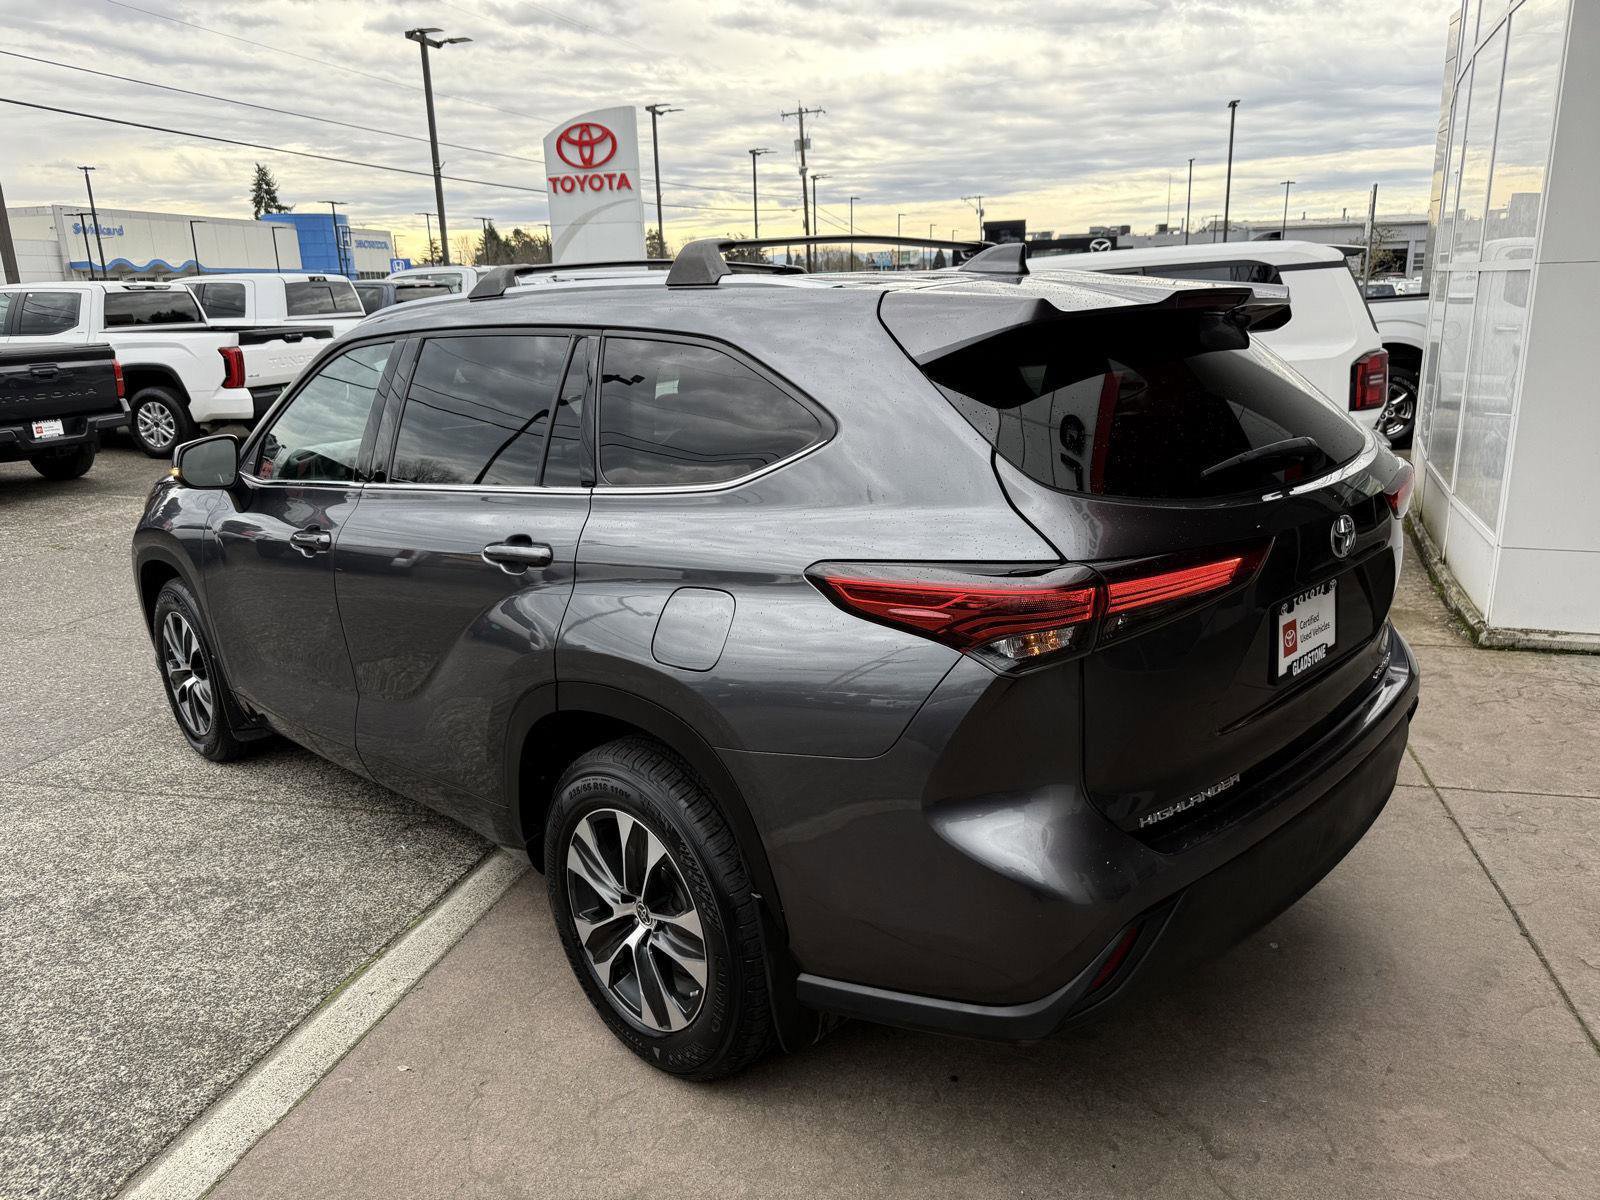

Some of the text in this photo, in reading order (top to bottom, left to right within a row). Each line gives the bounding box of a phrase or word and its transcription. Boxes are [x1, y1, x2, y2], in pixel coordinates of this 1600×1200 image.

[548, 172, 633, 194] TOYOTA
[1293, 584, 1325, 605] TOYOTA
[1299, 612, 1320, 630] Certified
[1300, 620, 1331, 644] Used Vehicles
[1292, 643, 1327, 676] GLADSTONE
[1139, 772, 1240, 829] HIGHLANDER
